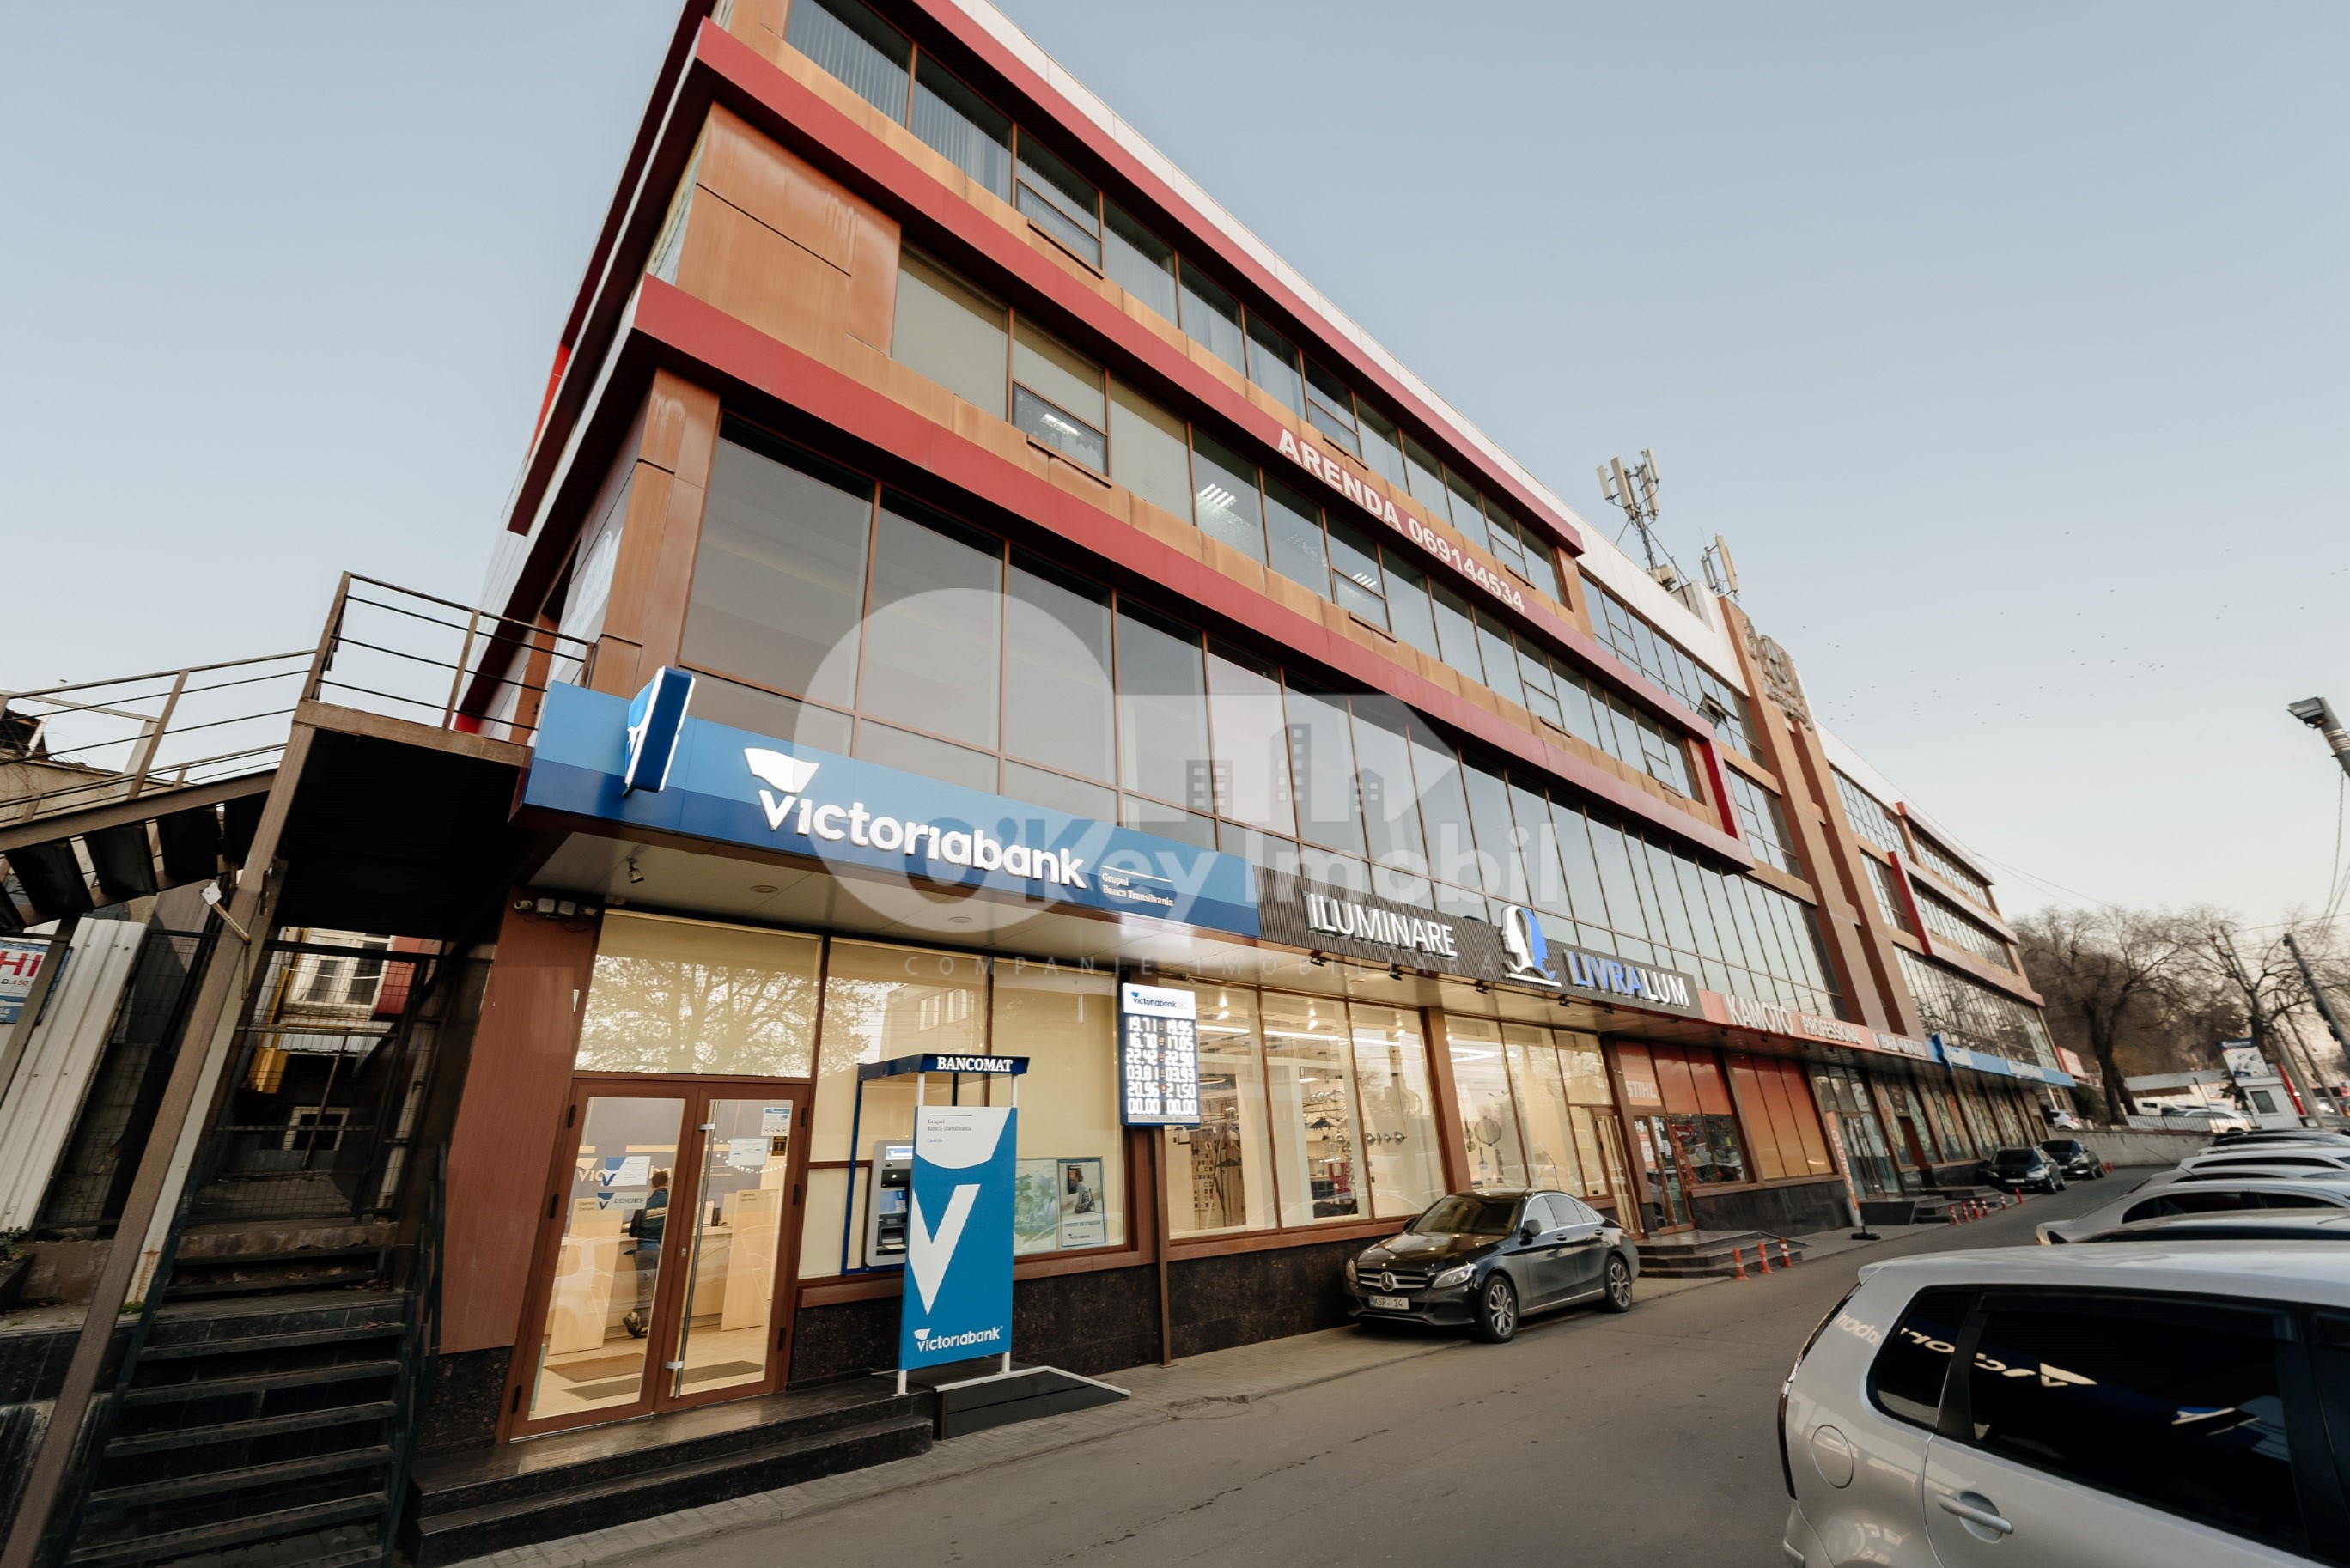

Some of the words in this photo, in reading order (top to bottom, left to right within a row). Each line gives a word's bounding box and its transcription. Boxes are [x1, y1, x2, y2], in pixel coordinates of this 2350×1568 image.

[1277, 428, 1403, 532] ARENDA
[1407, 518, 1526, 613] 069144534
[758, 789, 1087, 889] victoriabank
[1102, 872, 1129, 887] Grupul
[1103, 884, 1127, 897] Banca
[1128, 890, 1174, 907] Transilvania
[1305, 891, 1458, 960] ILUMINARE
[1564, 949, 1690, 1008] LIVRALUM
[1723, 993, 1794, 1036] KAMOTO
[1800, 1015, 1864, 1045] PROFESSIONAL
[936, 1056, 1014, 1073] BANCOMAT
[1625, 1080, 1658, 1099] STIHL
[916, 1327, 1001, 1353] victoriabank
